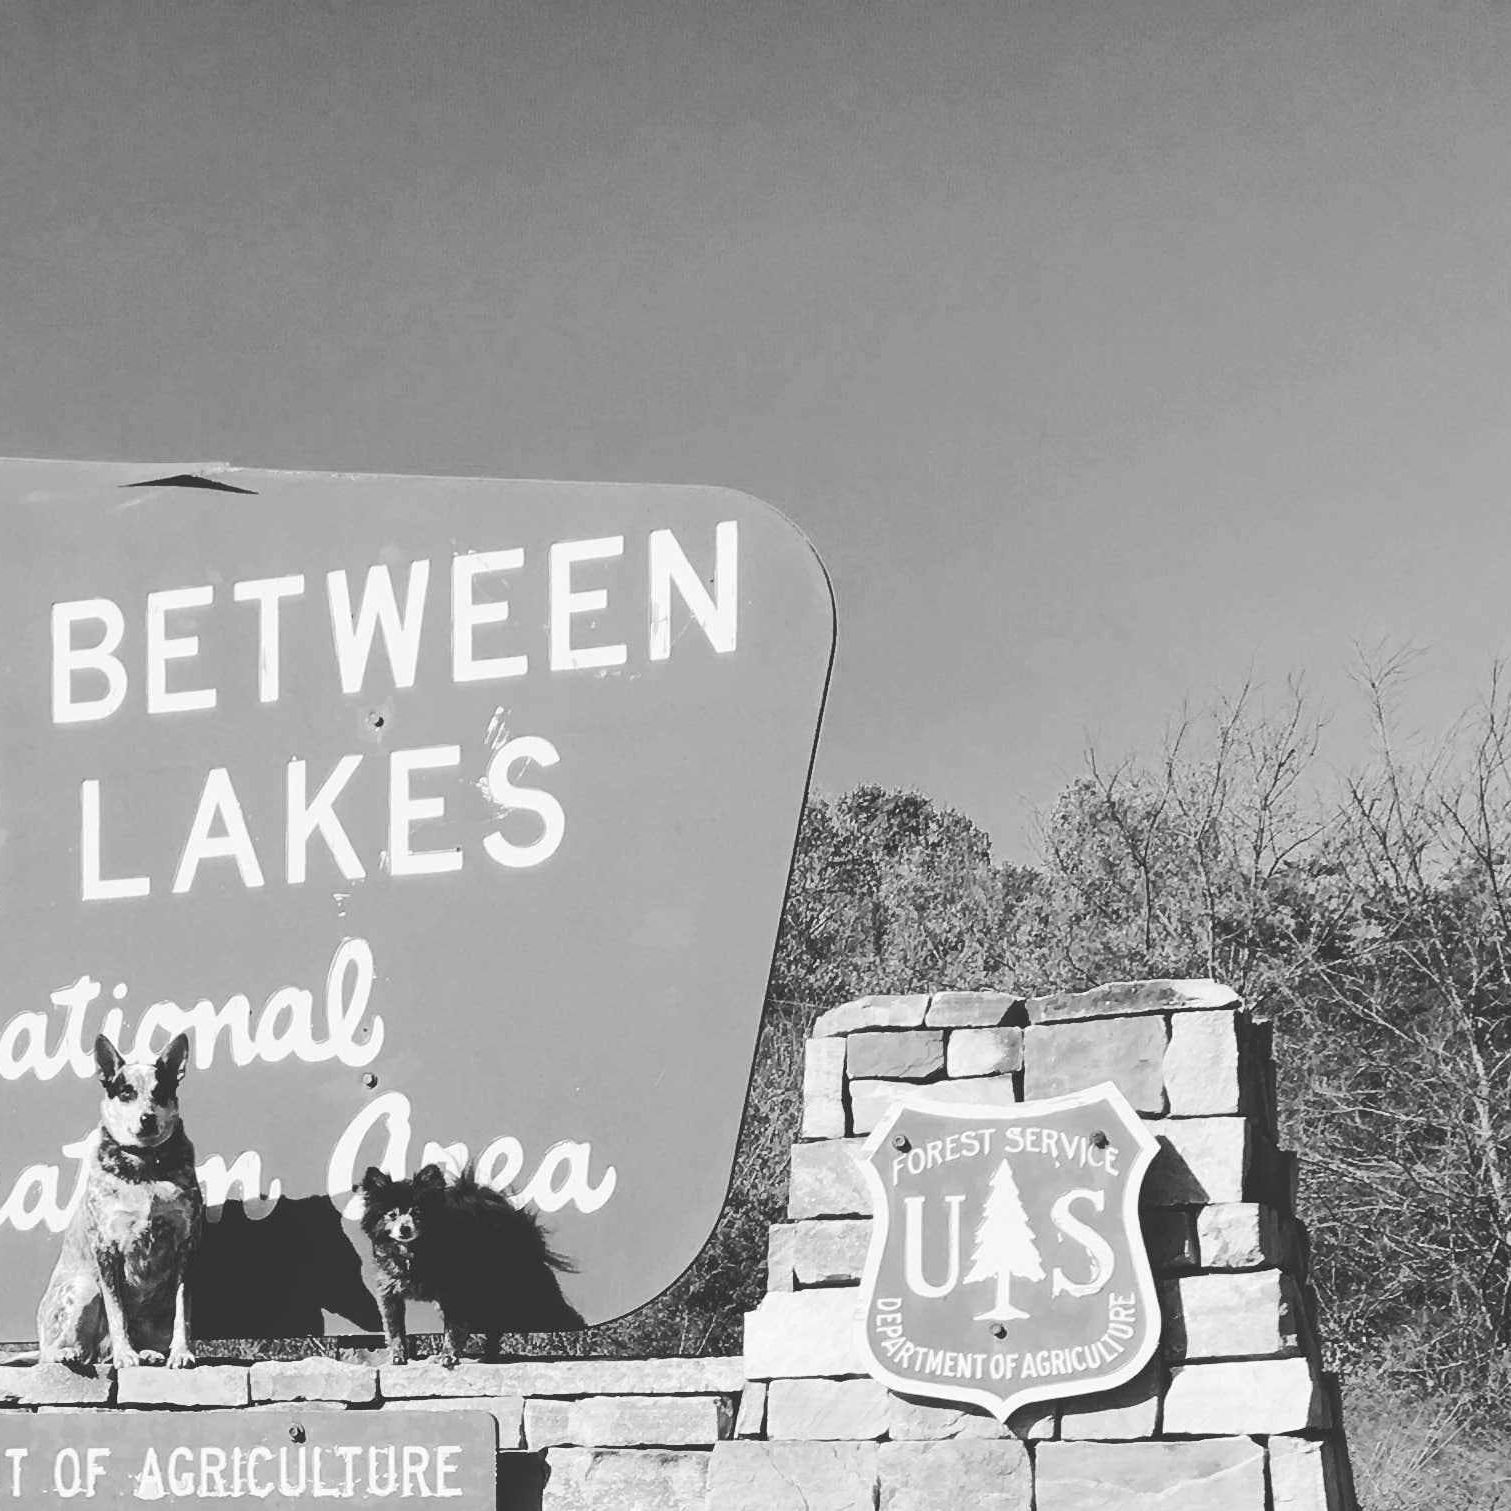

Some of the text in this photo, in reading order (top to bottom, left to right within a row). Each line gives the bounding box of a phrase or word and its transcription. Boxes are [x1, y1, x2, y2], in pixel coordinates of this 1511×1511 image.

[51, 520, 738, 724] BETWEEN
[81, 736, 565, 901] LAKES
[892, 1127, 1120, 1186] FOREST SERVICE
[876, 1291, 1136, 1380] DEPARTMENT OF AGRICULTURE
[53, 1446, 113, 1498] OF
[134, 1444, 464, 1500] AGRICULTURE
